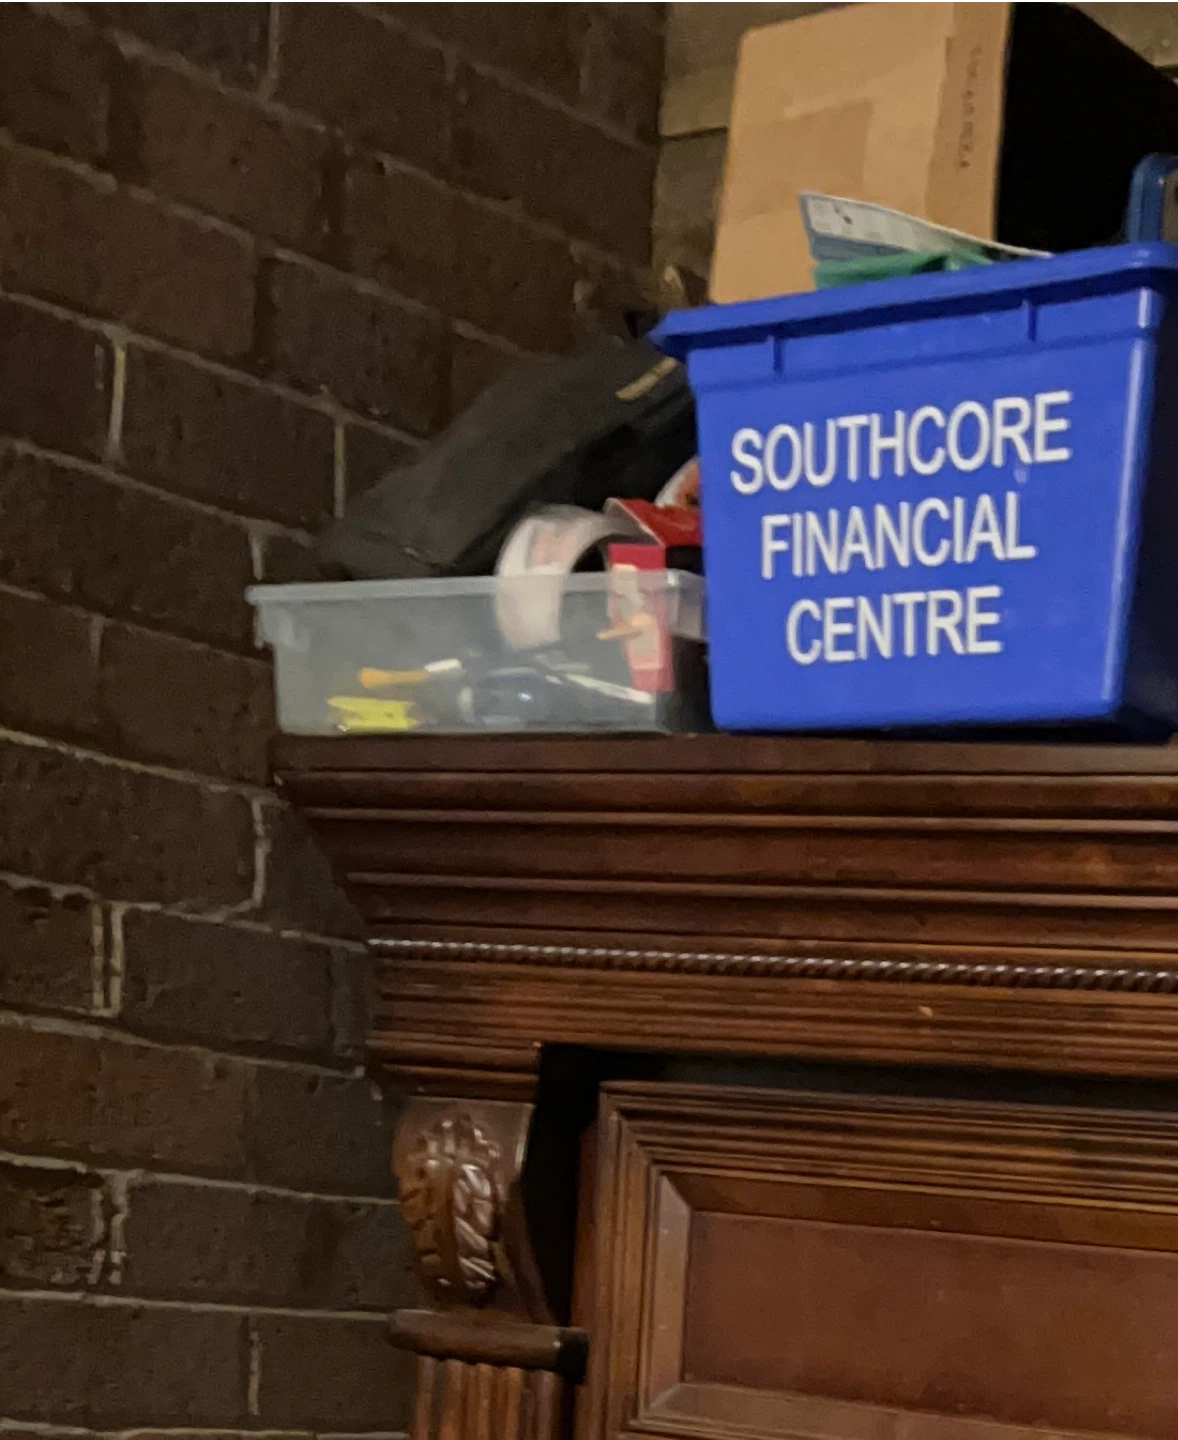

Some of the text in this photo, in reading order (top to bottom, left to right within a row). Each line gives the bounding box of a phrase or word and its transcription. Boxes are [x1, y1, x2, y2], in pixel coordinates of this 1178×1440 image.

[729, 389, 1072, 495] SOUTHCORE
[760, 491, 1037, 580] FINANCIAL
[785, 585, 1003, 665] CENTRE
